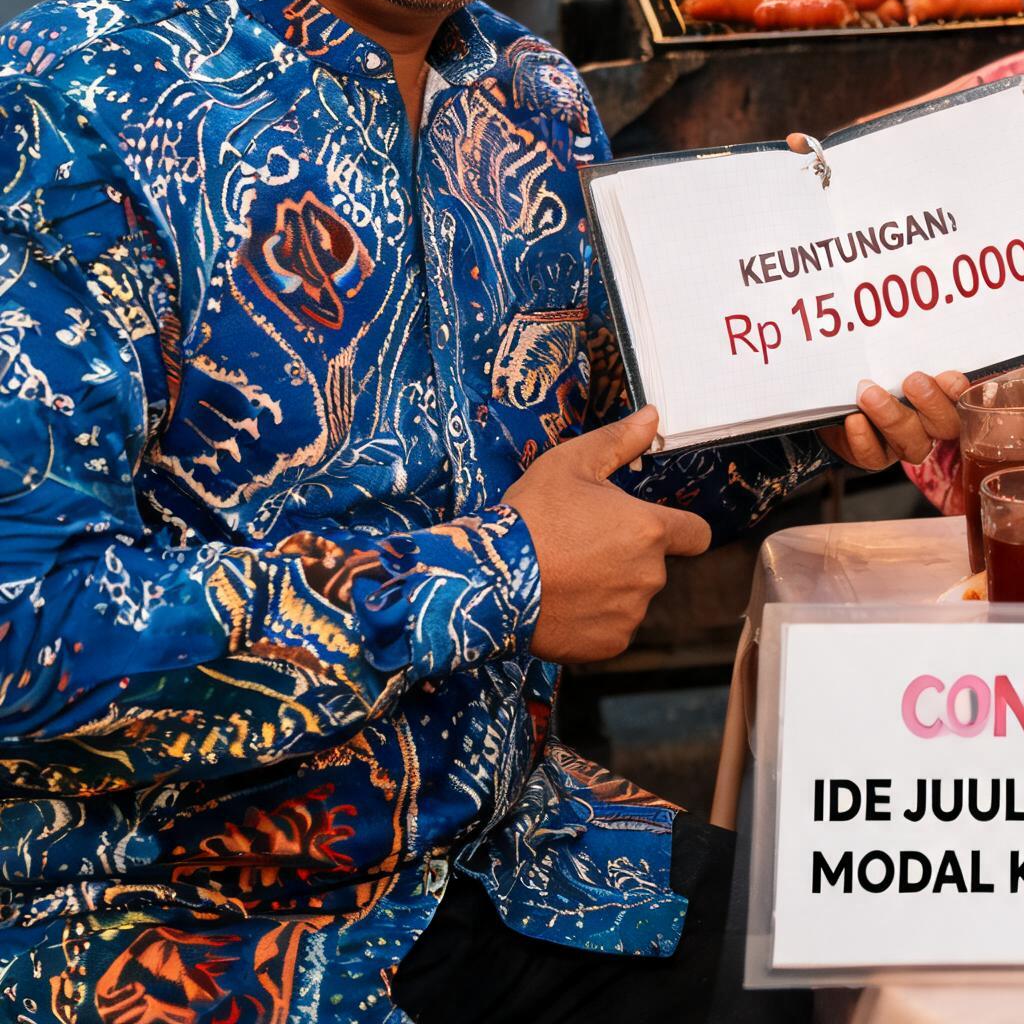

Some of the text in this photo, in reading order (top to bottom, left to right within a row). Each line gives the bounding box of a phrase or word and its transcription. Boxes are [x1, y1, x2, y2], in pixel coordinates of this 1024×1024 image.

[724, 313, 782, 365] Rp
[813, 778, 892, 822] IDE
[811, 849, 995, 894] MODAL
